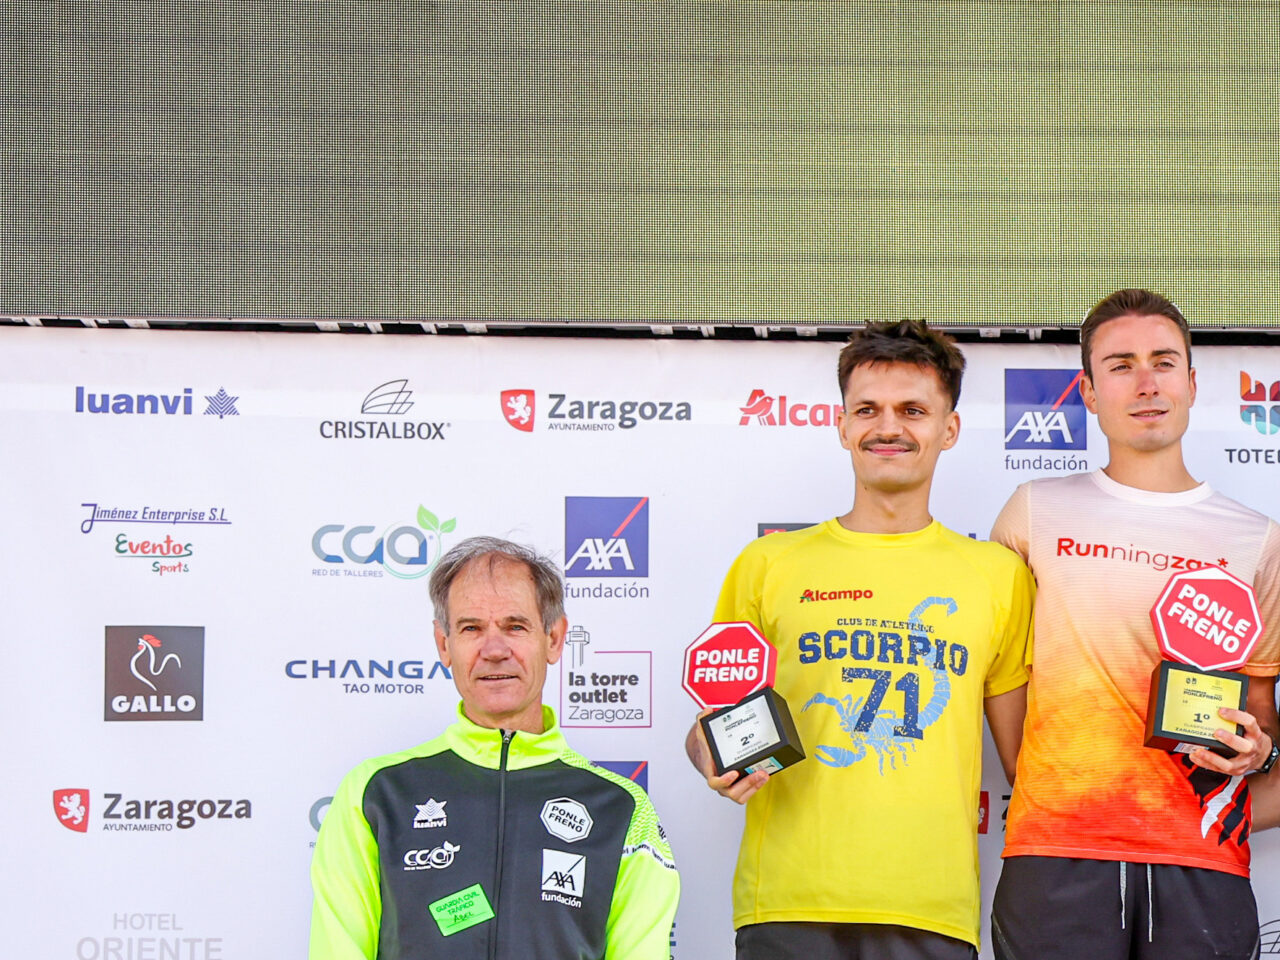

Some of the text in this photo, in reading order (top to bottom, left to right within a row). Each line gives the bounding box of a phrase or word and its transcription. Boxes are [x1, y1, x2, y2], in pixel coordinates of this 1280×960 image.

[75, 386, 193, 415] luanvi
[739, 389, 838, 427] Alca
[548, 393, 692, 429] Zaragoza
[548, 423, 615, 432] AYUNTAMIENTO
[1005, 411, 1074, 443] AXA
[1004, 454, 1089, 471] fundación
[81, 503, 205, 534] Jiménez Enterprise
[115, 533, 193, 557] Eventos
[564, 538, 635, 571] AXA
[152, 561, 189, 576] Sports
[312, 569, 384, 578] RED DE TALLERES
[564, 583, 650, 599] fundación
[800, 588, 874, 603] Alcampo
[1177, 584, 1251, 638] PONLE
[1167, 602, 1240, 654] FRENO
[695, 648, 760, 665] PONLE
[798, 629, 969, 677] SCORPIO
[285, 659, 456, 679] CHANGA
[693, 665, 759, 684] FRENO
[568, 671, 640, 687] la torre
[343, 683, 424, 695] TAO MOTOR
[568, 689, 629, 704] outlet
[111, 695, 197, 713] GALLO
[841, 666, 925, 741] 71
[568, 706, 645, 723] Zaragoza
[103, 793, 253, 829] Zaragoza
[551, 805, 586, 827] PONLE
[103, 823, 173, 832] AYUNTAMIENTO
[548, 812, 583, 834] FRENO
[542, 870, 576, 891] AXA
[541, 891, 582, 909] fundación
[112, 913, 184, 931] HOTEL
